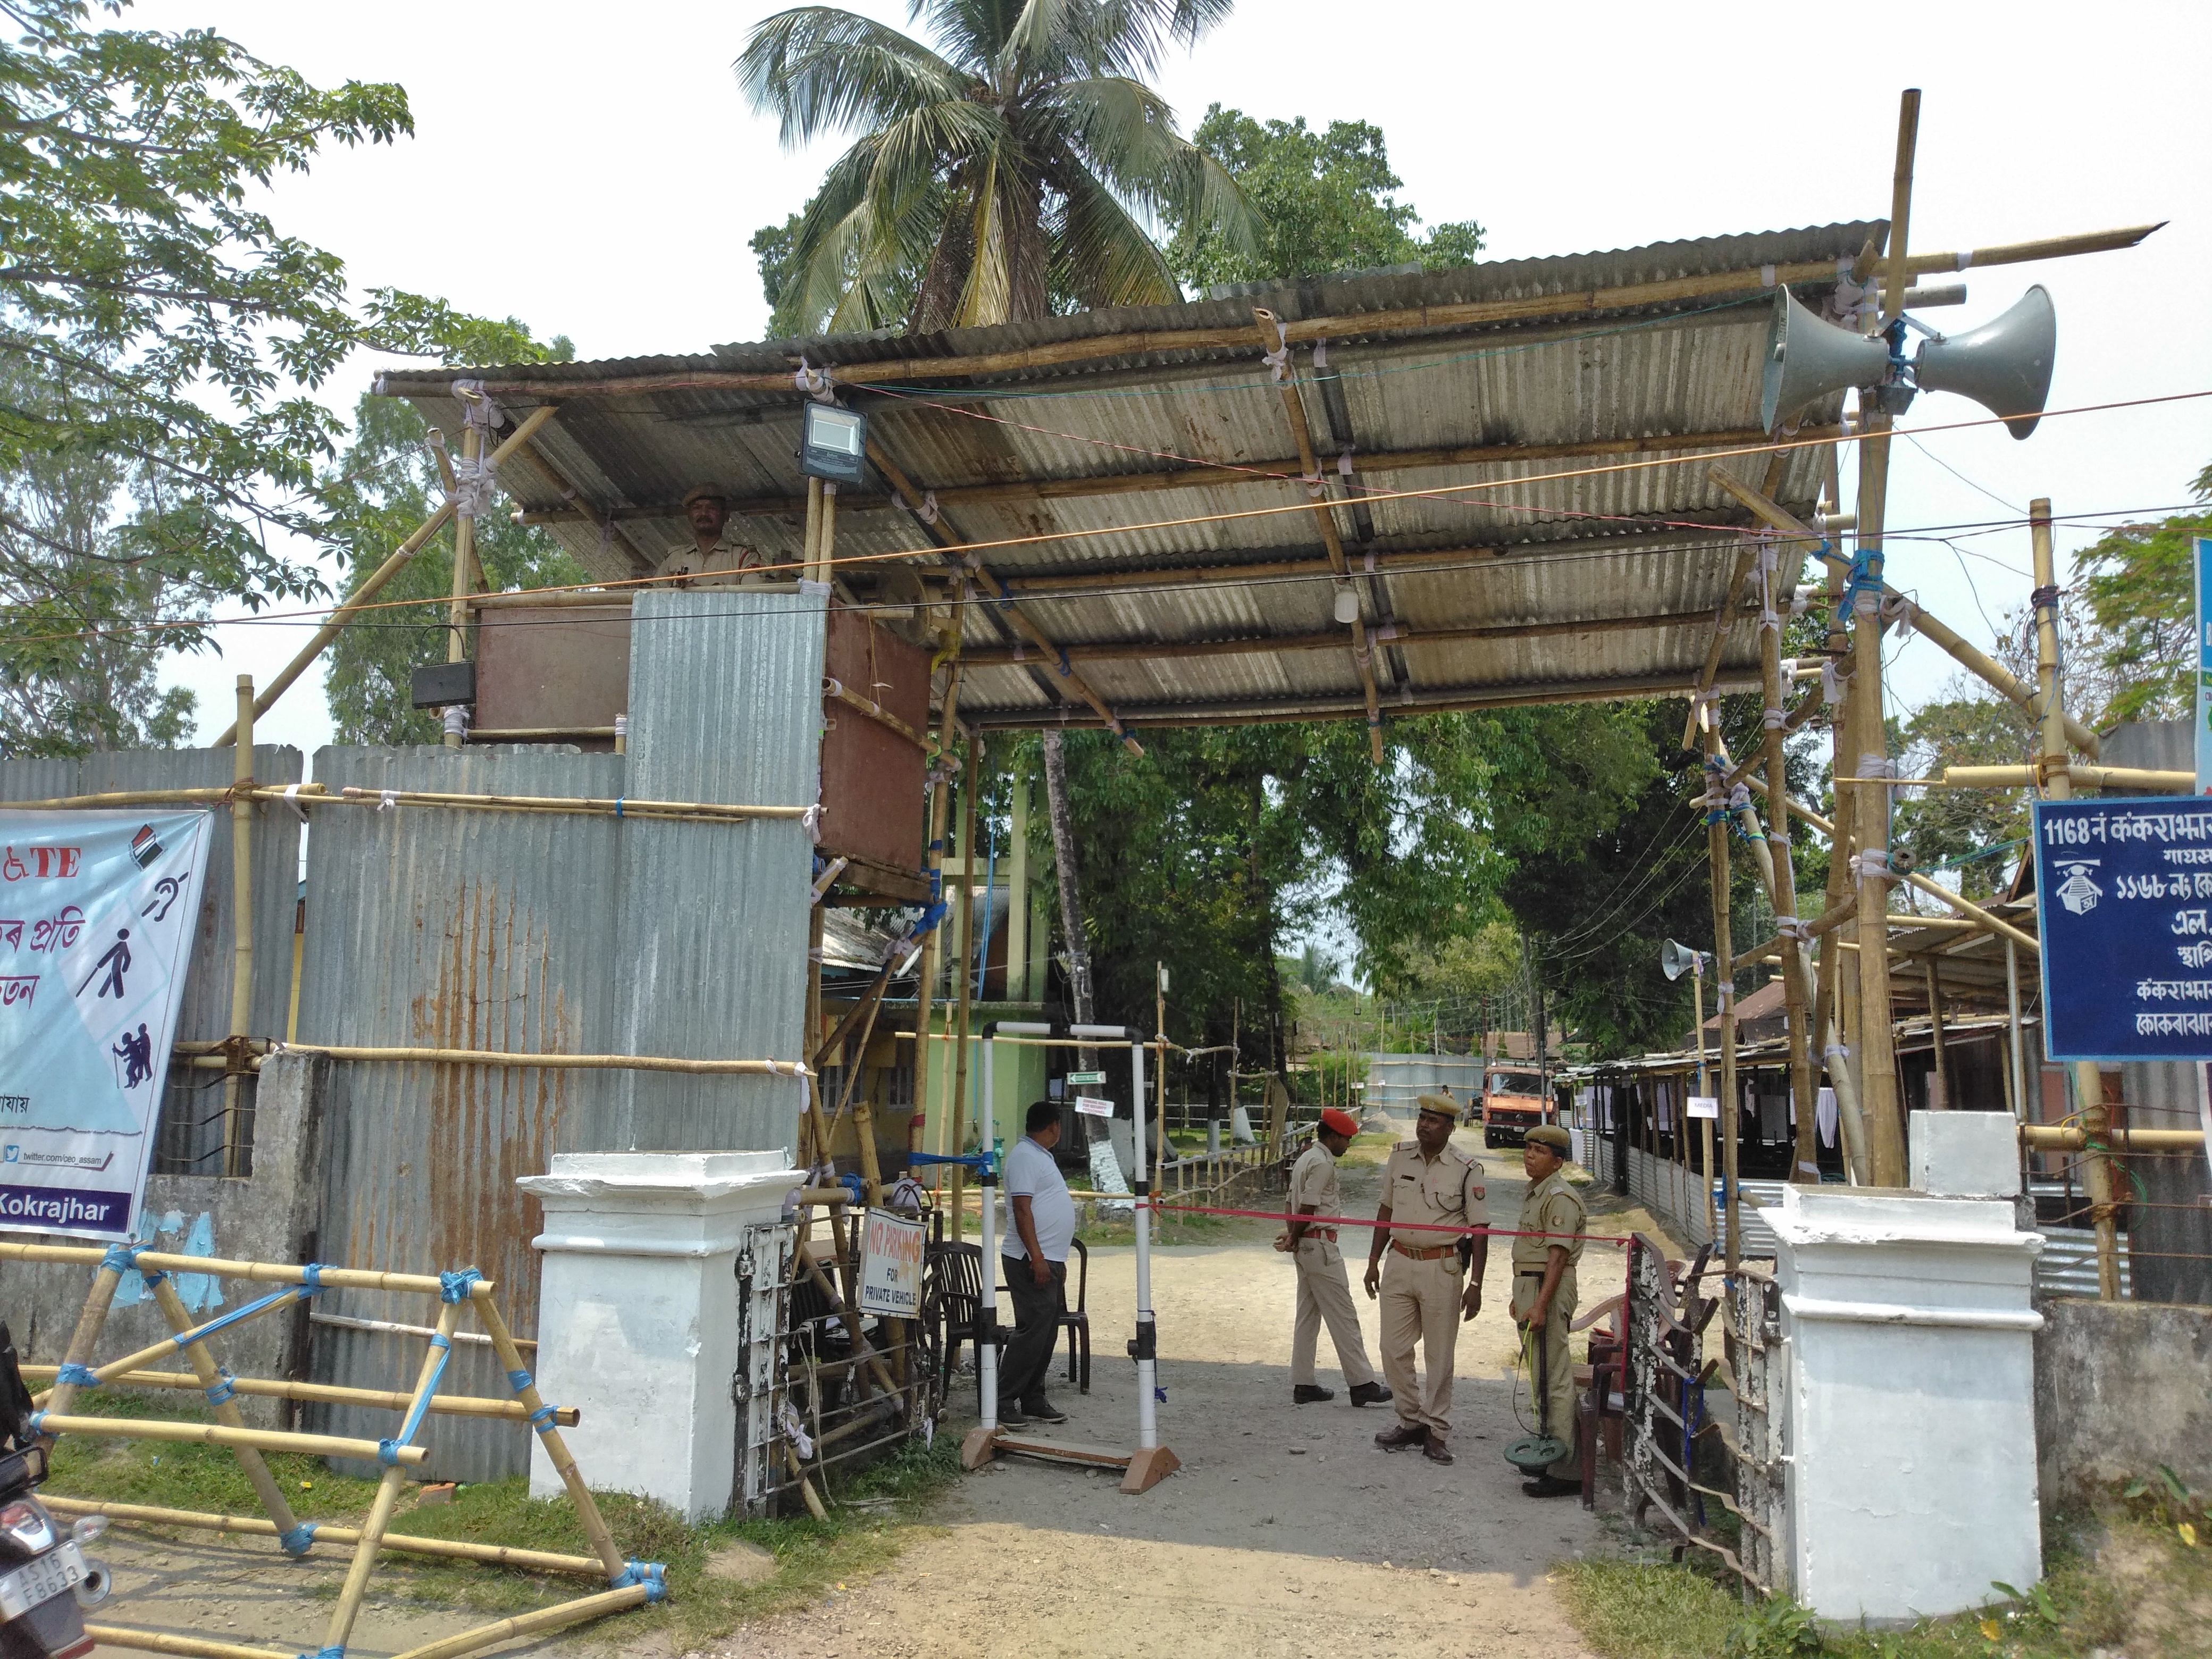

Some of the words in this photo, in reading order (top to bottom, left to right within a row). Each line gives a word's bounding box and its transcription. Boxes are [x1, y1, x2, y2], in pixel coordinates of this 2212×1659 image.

[23, 1152, 102, 1165] twitter.com/ceo_assam
[869, 1220, 884, 1255] NO
[883, 1224, 921, 1263] PARKING
[886, 1268, 898, 1283] FOR
[865, 1285, 890, 1303] PRIVATE
[892, 1289, 916, 1306] VEHICLE
